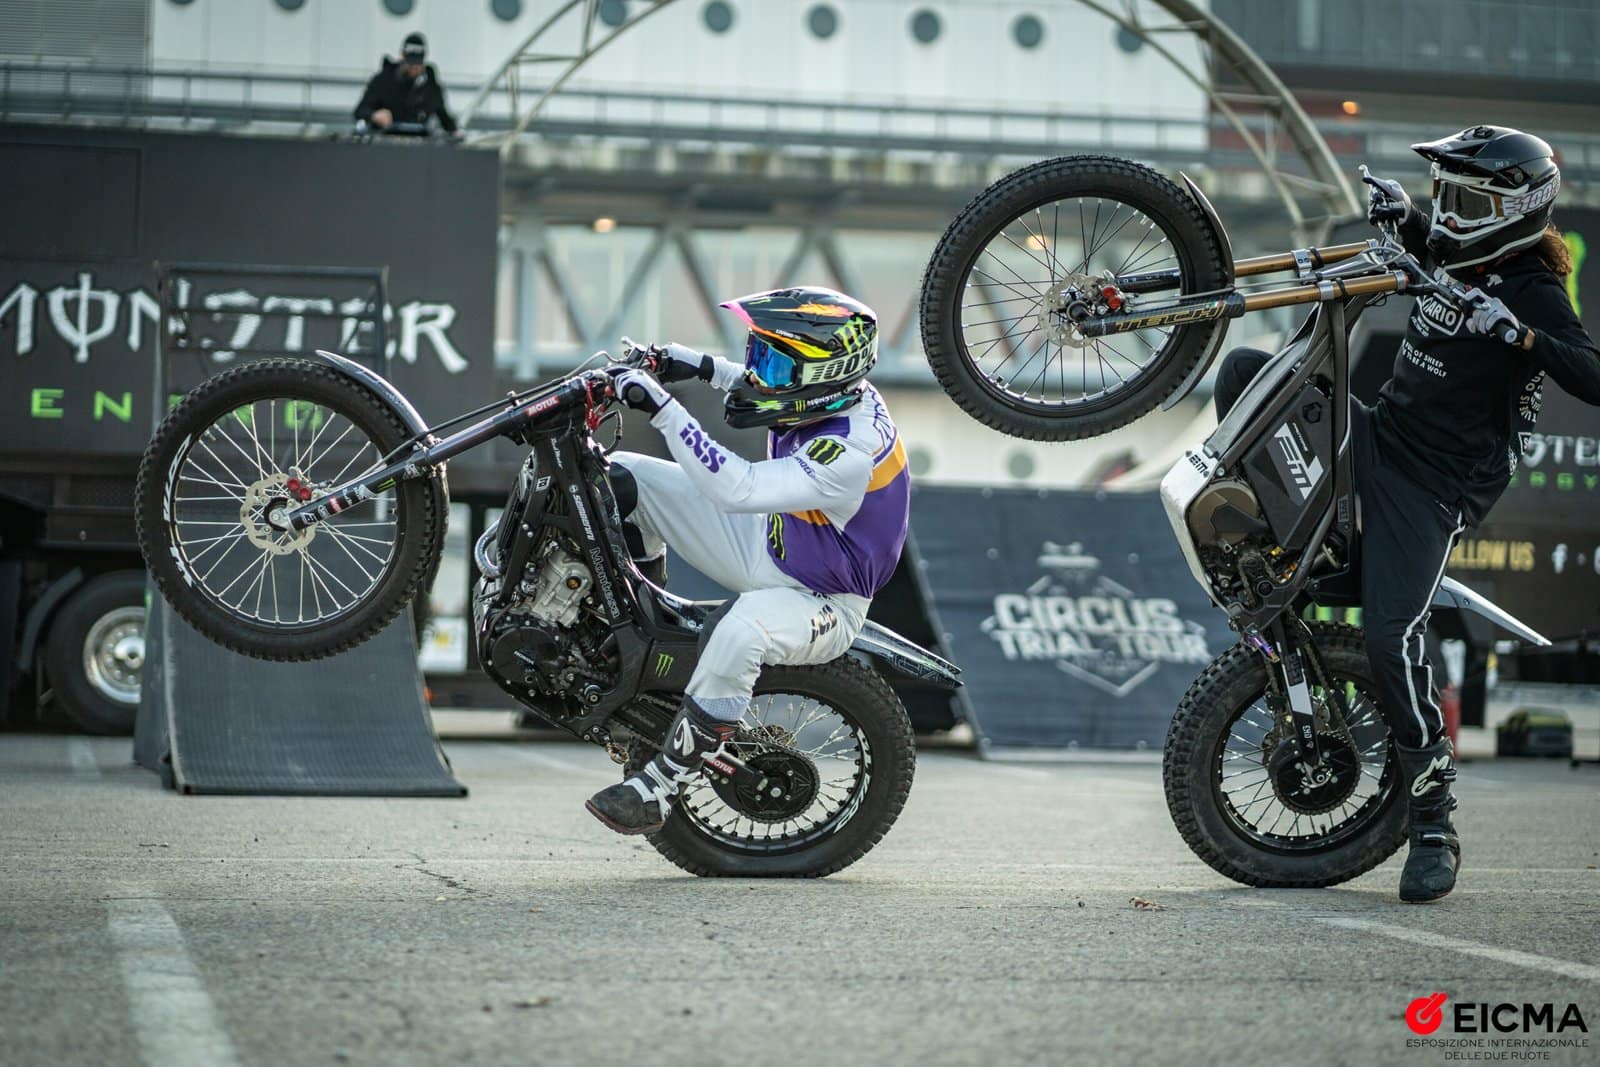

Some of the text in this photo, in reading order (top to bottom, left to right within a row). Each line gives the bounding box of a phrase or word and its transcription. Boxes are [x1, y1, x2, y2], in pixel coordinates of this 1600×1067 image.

[1509, 541, 1534, 571] US
[994, 594, 1183, 632] CIRCUS
[993, 629, 1099, 659] TRIAL
[1114, 632, 1210, 664] TOUR
